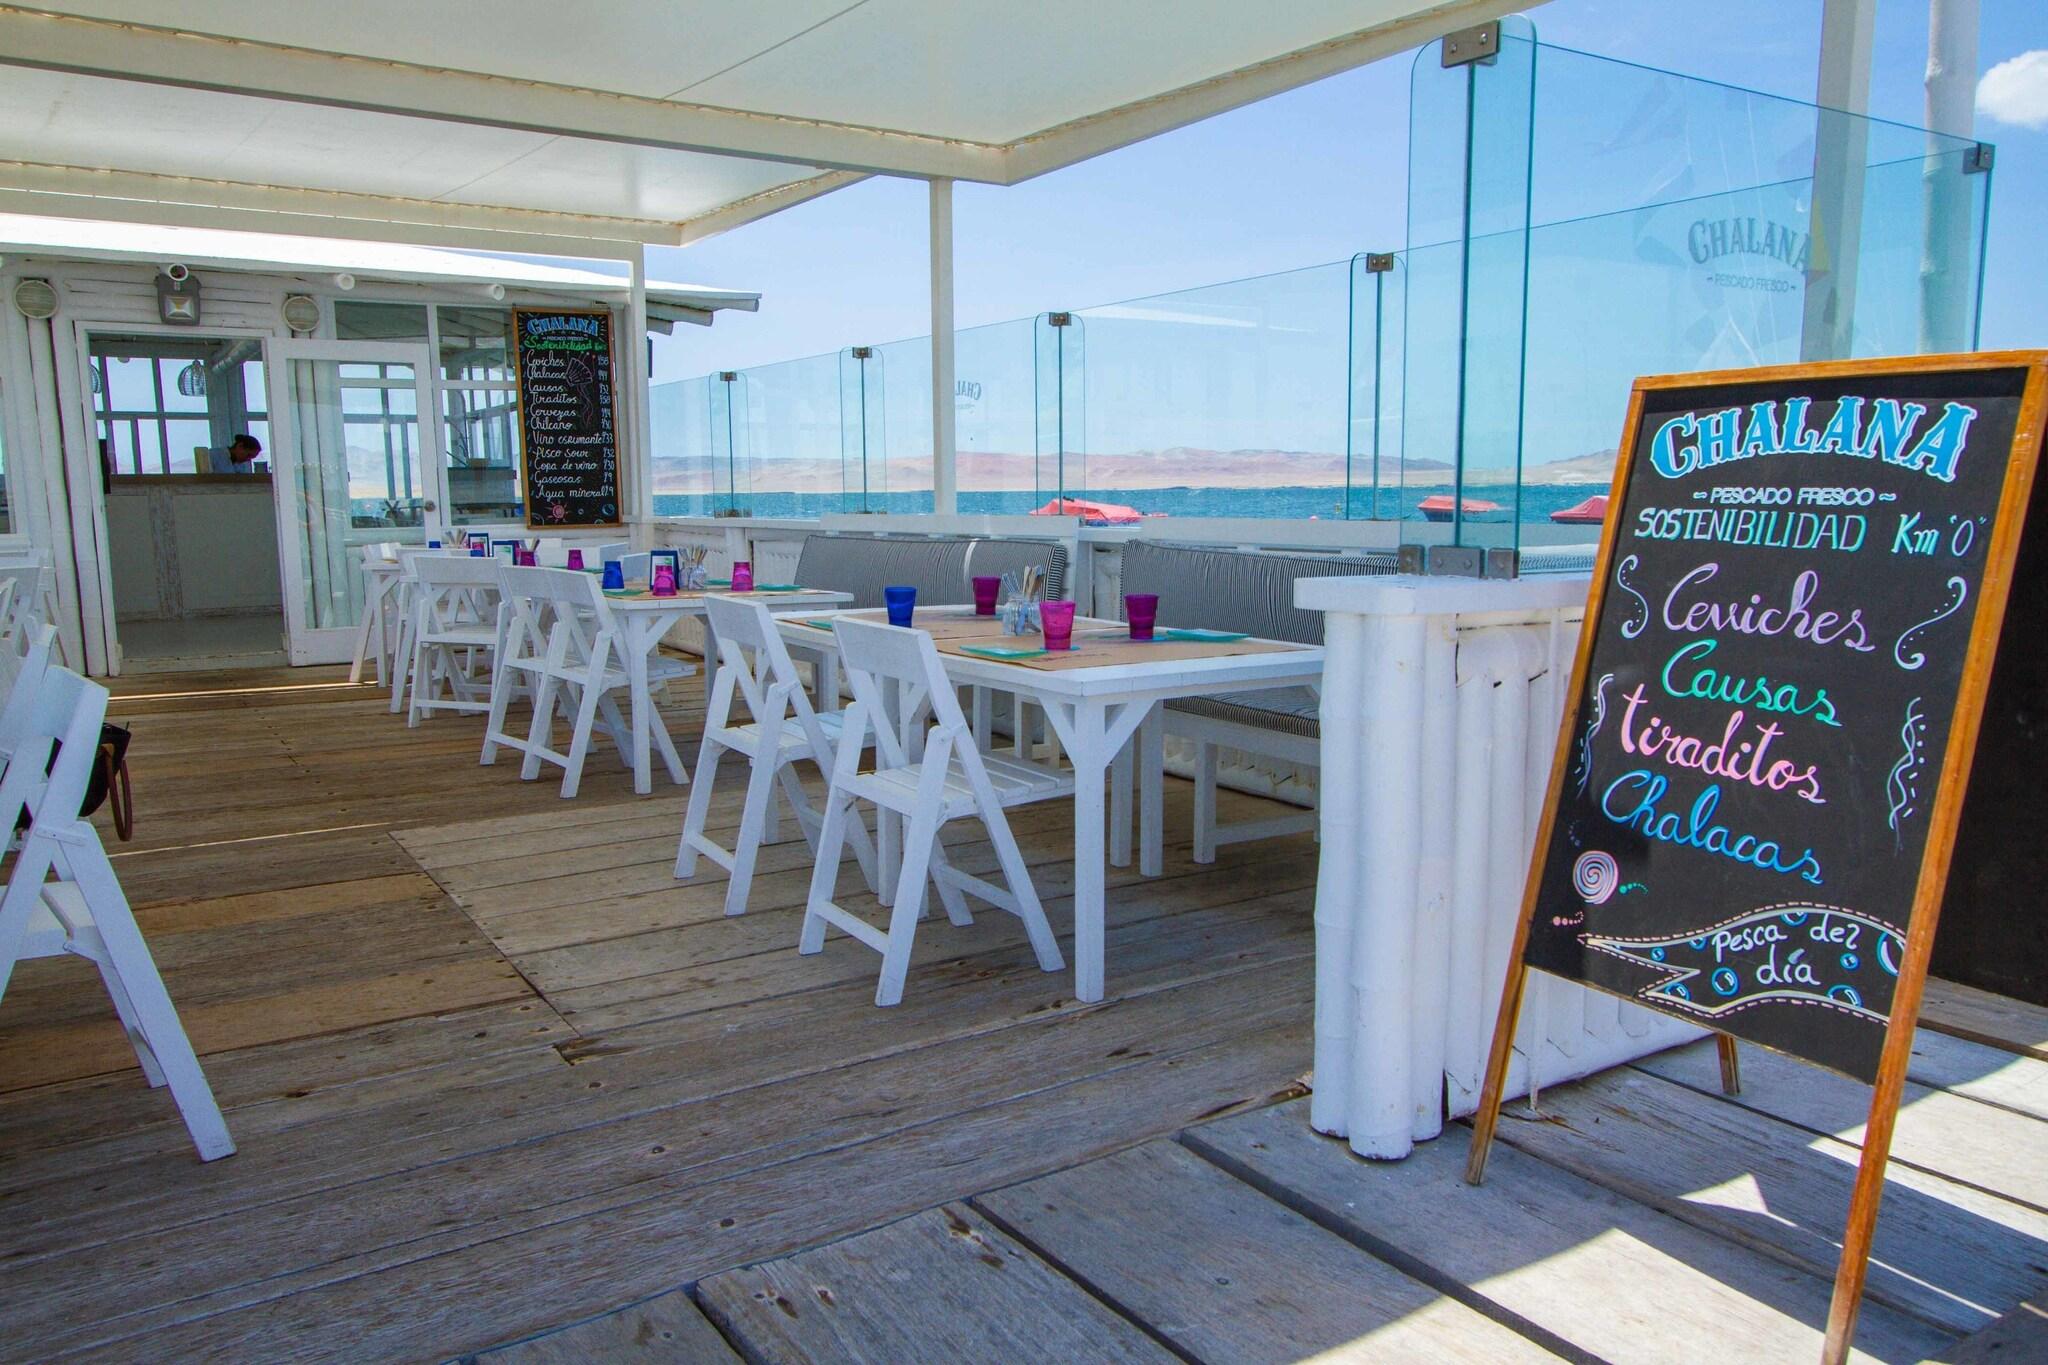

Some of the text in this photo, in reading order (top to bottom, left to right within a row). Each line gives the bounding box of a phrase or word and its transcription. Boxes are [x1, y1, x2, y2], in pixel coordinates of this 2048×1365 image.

[527, 316, 599, 337] CHALANA
[533, 430, 554, 445] Vino
[1650, 396, 1977, 483] CHALANA
[562, 459, 573, 470] de
[1710, 486, 1875, 506] PESCADO FRESCO
[1634, 507, 1868, 552] SOSTENIBILIDAD
[1890, 511, 1941, 556] Km
[1663, 562, 1876, 652] Ceviches
[1662, 638, 1844, 727] Causas
[1621, 683, 1827, 804] tiraditos
[1601, 769, 1824, 885] Chalacas
[1755, 943, 1822, 986] día
